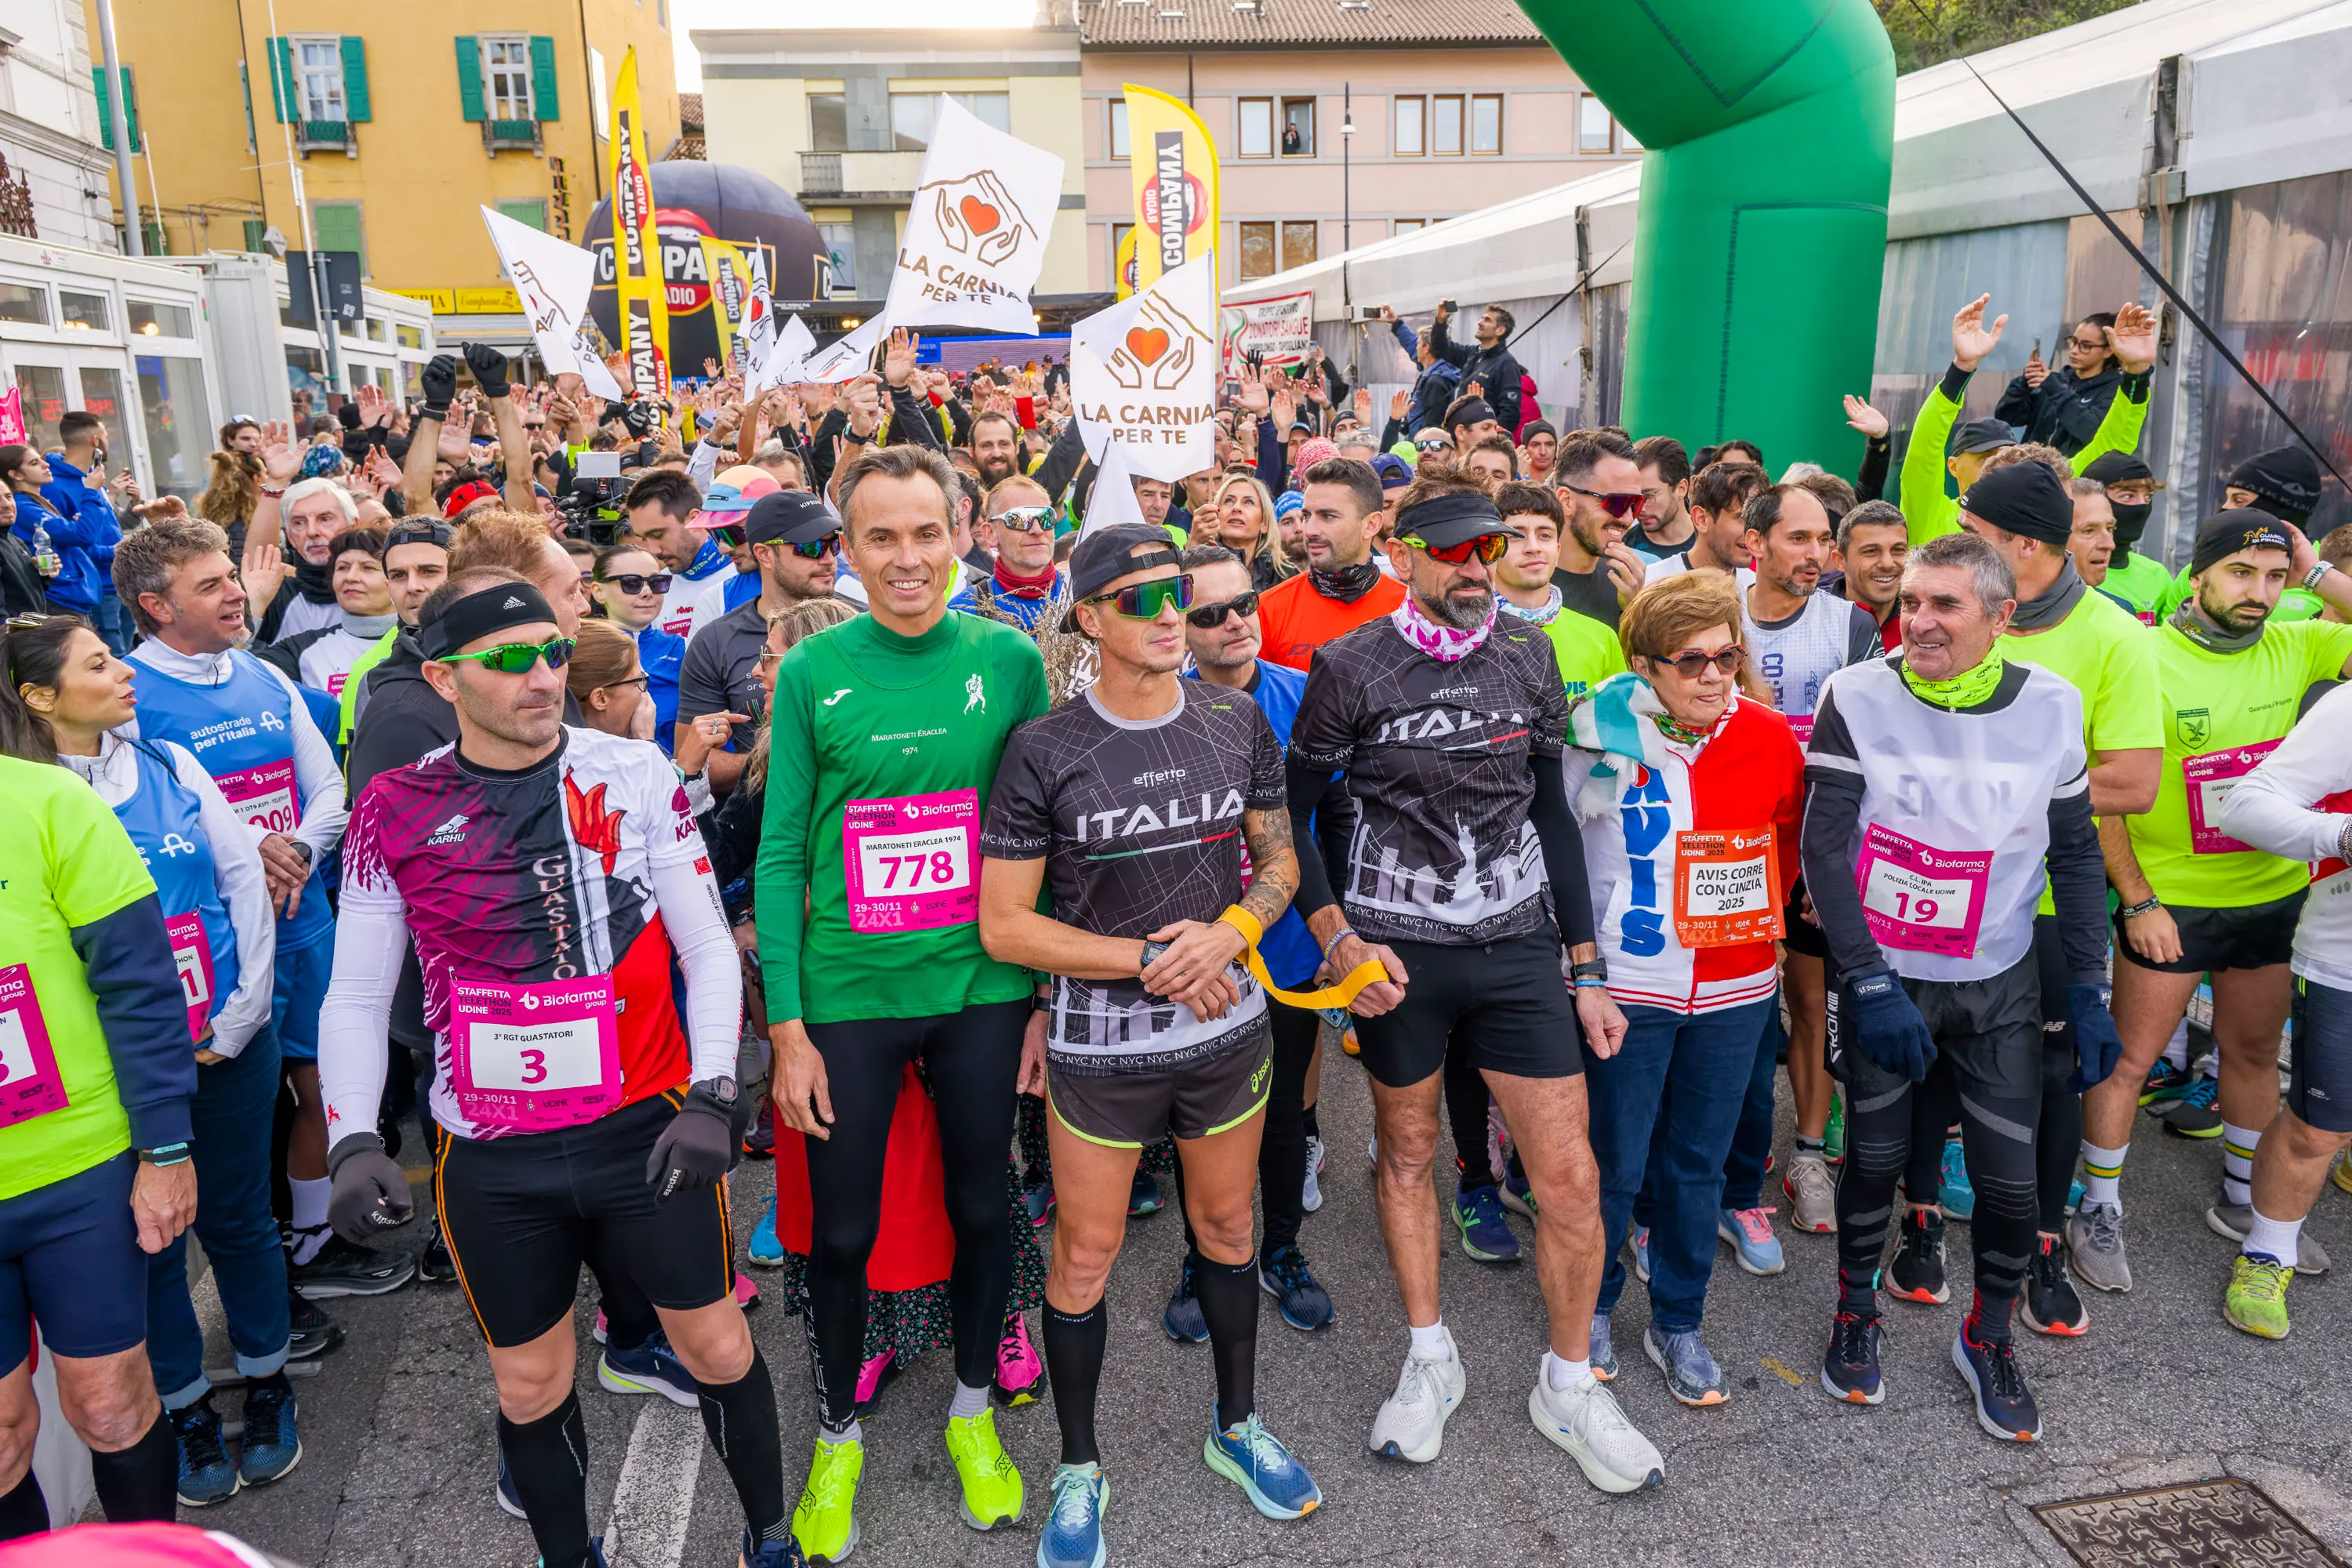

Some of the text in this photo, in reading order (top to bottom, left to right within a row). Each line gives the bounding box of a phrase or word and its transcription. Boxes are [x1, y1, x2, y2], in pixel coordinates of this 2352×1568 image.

[619, 125, 641, 265] COMPANY
[634, 175, 647, 216] RADIO
[898, 248, 1023, 303] LA CARNIA
[921, 283, 993, 306] PER TE
[1081, 403, 1214, 426] LA CARNIA
[1113, 429, 1187, 445] PER TE
[503, 601, 527, 610] adidas
[1430, 687, 1479, 699] effetto
[190, 717, 252, 740] autostrade
[194, 735, 217, 753] per
[1545, 737, 1564, 746] NYC
[902, 746, 919, 755] 1974
[1335, 745, 1355, 760] NYC
[2187, 753, 2231, 766] STAFFETTA
[265, 768, 291, 782] Biofarma
[1134, 768, 1185, 788] effetto
[2189, 768, 2214, 777] UDINE
[1256, 788, 1276, 797] NYC
[848, 804, 895, 814] STAFFETTA
[922, 802, 973, 816] Biofarma
[1077, 788, 1244, 843] ITALIA
[848, 812, 895, 821] TELETHON
[427, 832, 466, 845] KARHU
[866, 842, 912, 851] MARATONETI
[913, 838, 943, 848] ERACLEA
[999, 837, 1021, 848] NYC
[1024, 837, 1047, 847] NYC
[1871, 829, 1914, 851] STAFFETTA
[1868, 842, 1911, 863] UDINE 2025
[1870, 836, 1913, 856] TELETHON
[879, 851, 954, 889] 778
[1935, 858, 1986, 869] Biofarma
[1697, 863, 1763, 880] AVIS CORRE
[1696, 878, 1762, 896] CON CINZIA
[1883, 873, 1908, 887] POLIZIA
[1909, 882, 1934, 895] LOCALE
[855, 902, 902, 913] 29-30/11
[925, 901, 947, 909] UDINE
[1718, 897, 1744, 911] 2025
[1895, 892, 1939, 923] 19
[856, 911, 904, 928] 24X1
[1355, 894, 1541, 935] NYC NYC NYC NYC NYC NYC NYC NYC NYC
[1678, 920, 1718, 930] 29-30/11
[1735, 919, 1751, 928] UDINE
[183, 930, 199, 940] group
[1, 989, 26, 1002] group
[458, 987, 511, 1000] STAFFETTA
[543, 989, 606, 1007] Biofarma
[458, 996, 511, 1007] TELETHON
[585, 999, 607, 1009] group
[491, 1007, 512, 1016] 2025
[521, 1030, 573, 1041] GUASTATORI
[1066, 1056, 1088, 1065] NYC
[1092, 1056, 1116, 1065] NYC
[1120, 1055, 1144, 1065] NYC
[1148, 1053, 1171, 1064] NYC
[1175, 1047, 1198, 1061] NYC
[1200, 1039, 1219, 1054] NYC
[1220, 1029, 1239, 1045] NYC
[1240, 1022, 1256, 1036] NYC
[520, 1049, 548, 1084] 3
[1258, 1054, 1270, 1081] asics
[463, 1093, 517, 1105] 29-30/11
[543, 1098, 570, 1109] UDINE
[467, 1102, 519, 1121] 24X1
